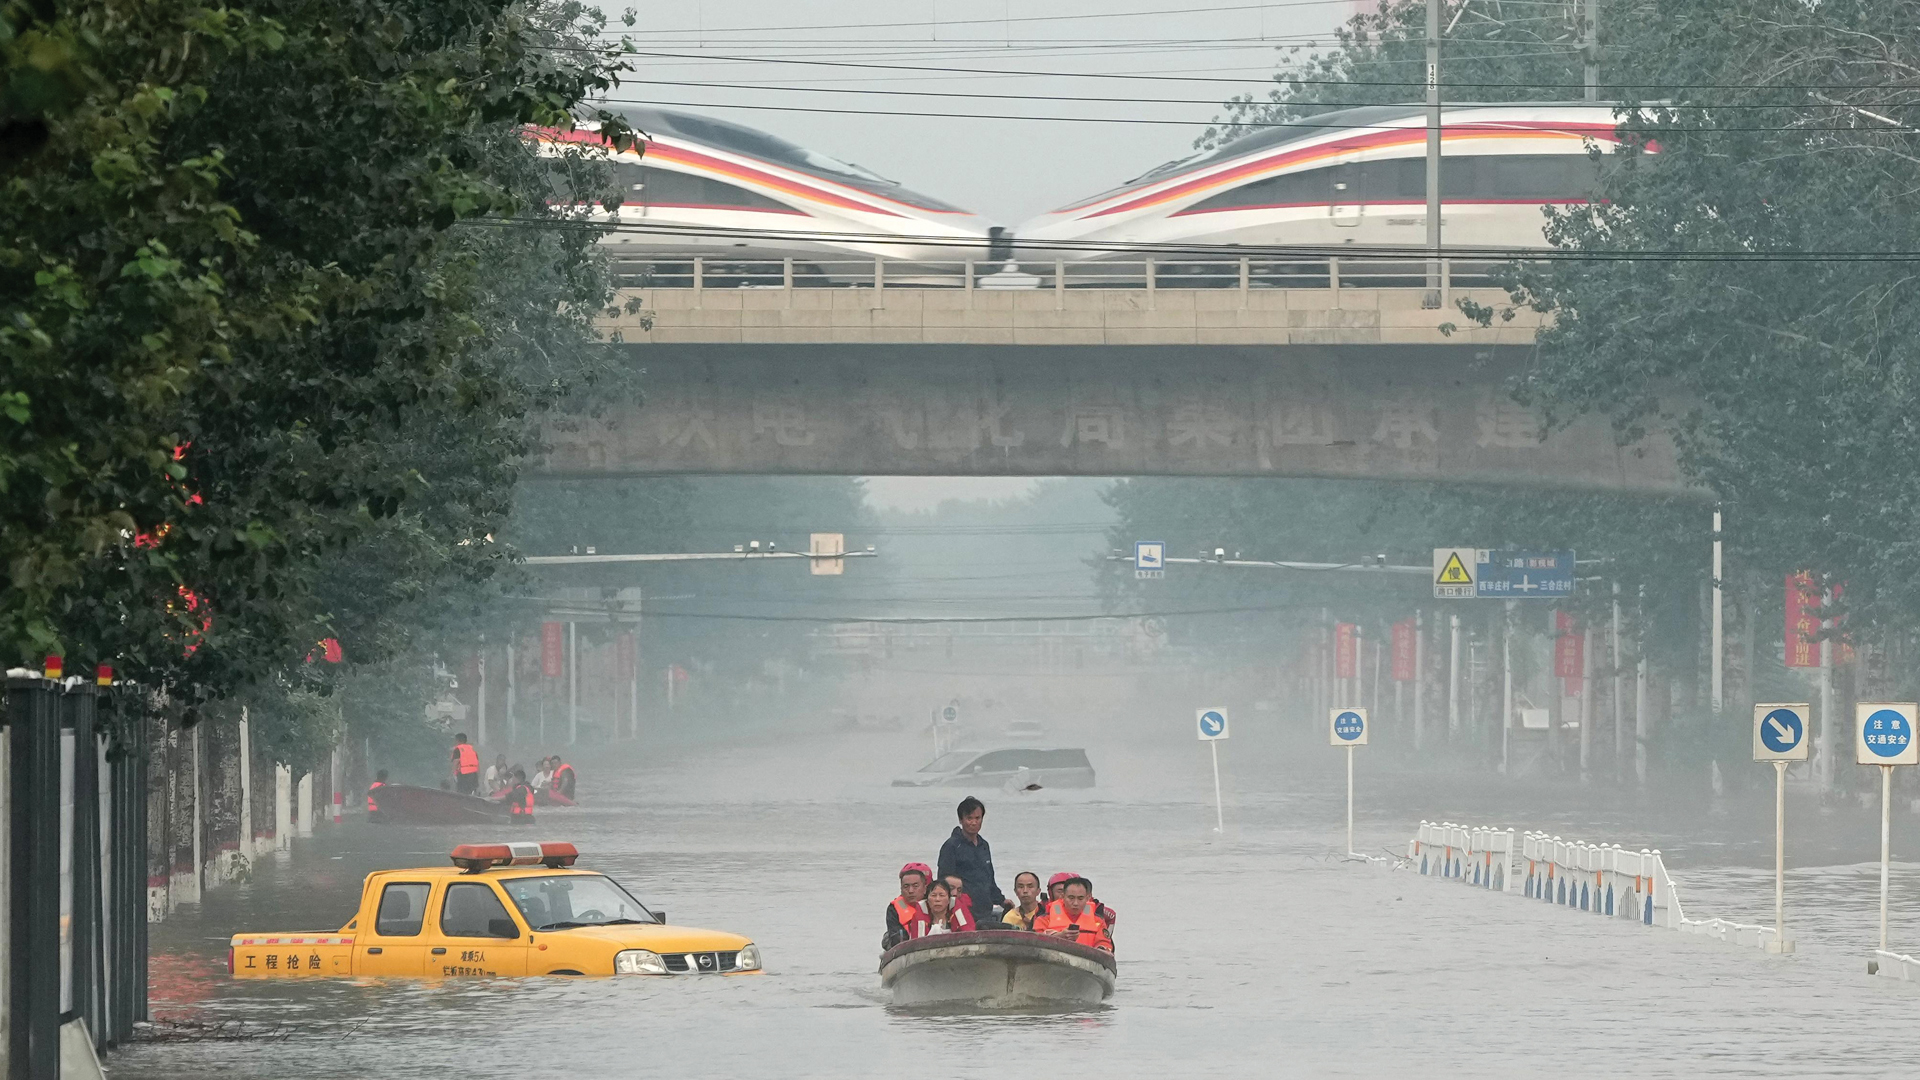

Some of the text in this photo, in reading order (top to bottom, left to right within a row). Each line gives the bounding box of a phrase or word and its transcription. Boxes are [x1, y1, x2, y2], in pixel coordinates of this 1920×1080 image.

[1479, 581, 1510, 591] 西辛庄村
[1540, 581, 1571, 591] 三合庄村
[1437, 587, 1472, 597] 路口慢行
[1337, 726, 1361, 734] 交通安全
[1873, 720, 1901, 730] 注意
[1867, 734, 1907, 745] 交通安全
[244, 954, 321, 970] 工程抢险
